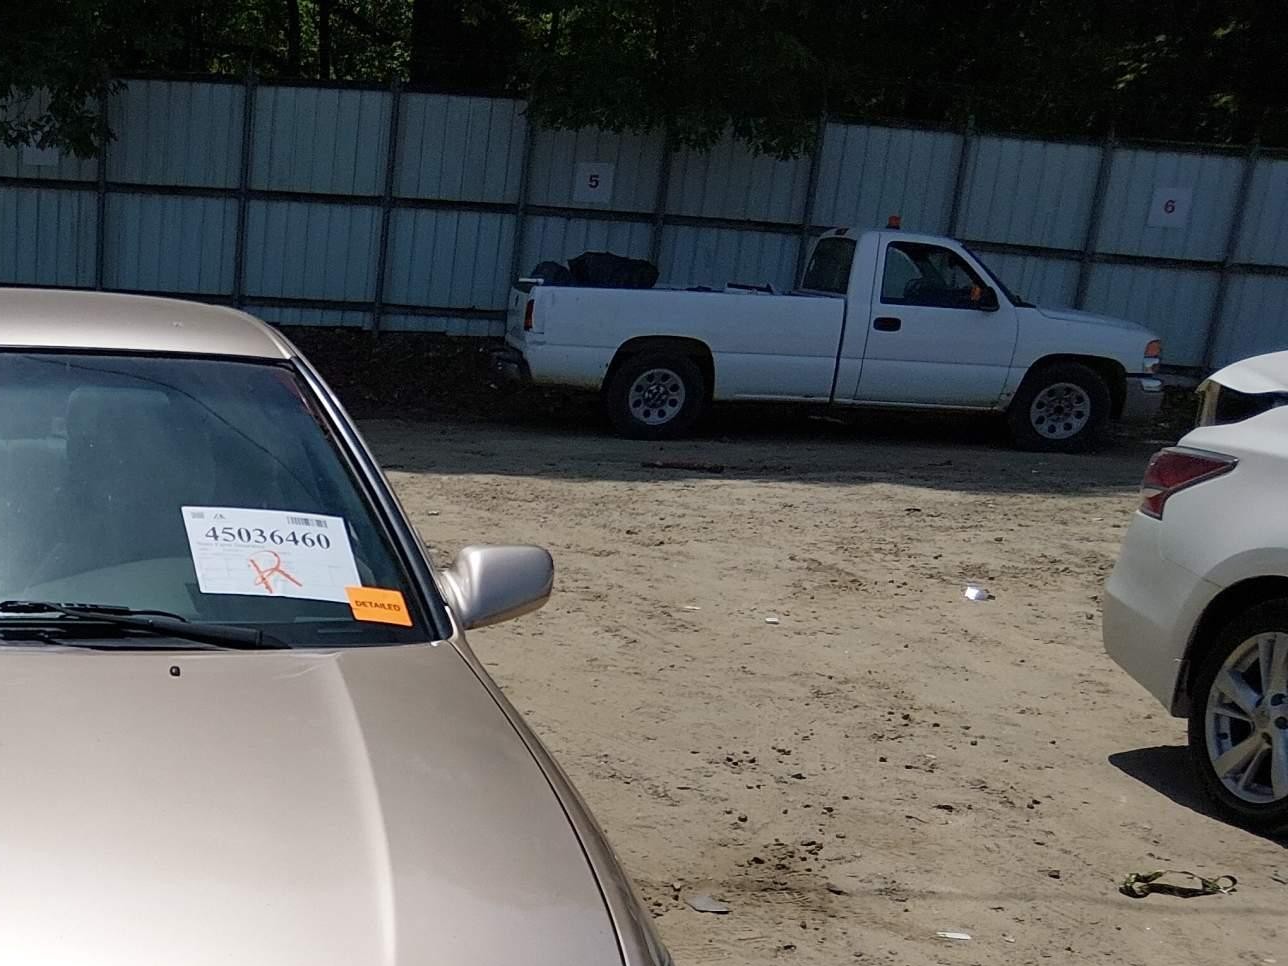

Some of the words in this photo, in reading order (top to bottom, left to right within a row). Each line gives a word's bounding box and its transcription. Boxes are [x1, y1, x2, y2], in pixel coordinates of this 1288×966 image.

[588, 175, 600, 189] 5
[1163, 200, 1176, 214] 6
[204, 526, 331, 550] 45036460
[248, 550, 303, 594] R
[354, 599, 401, 613] DETAILED
